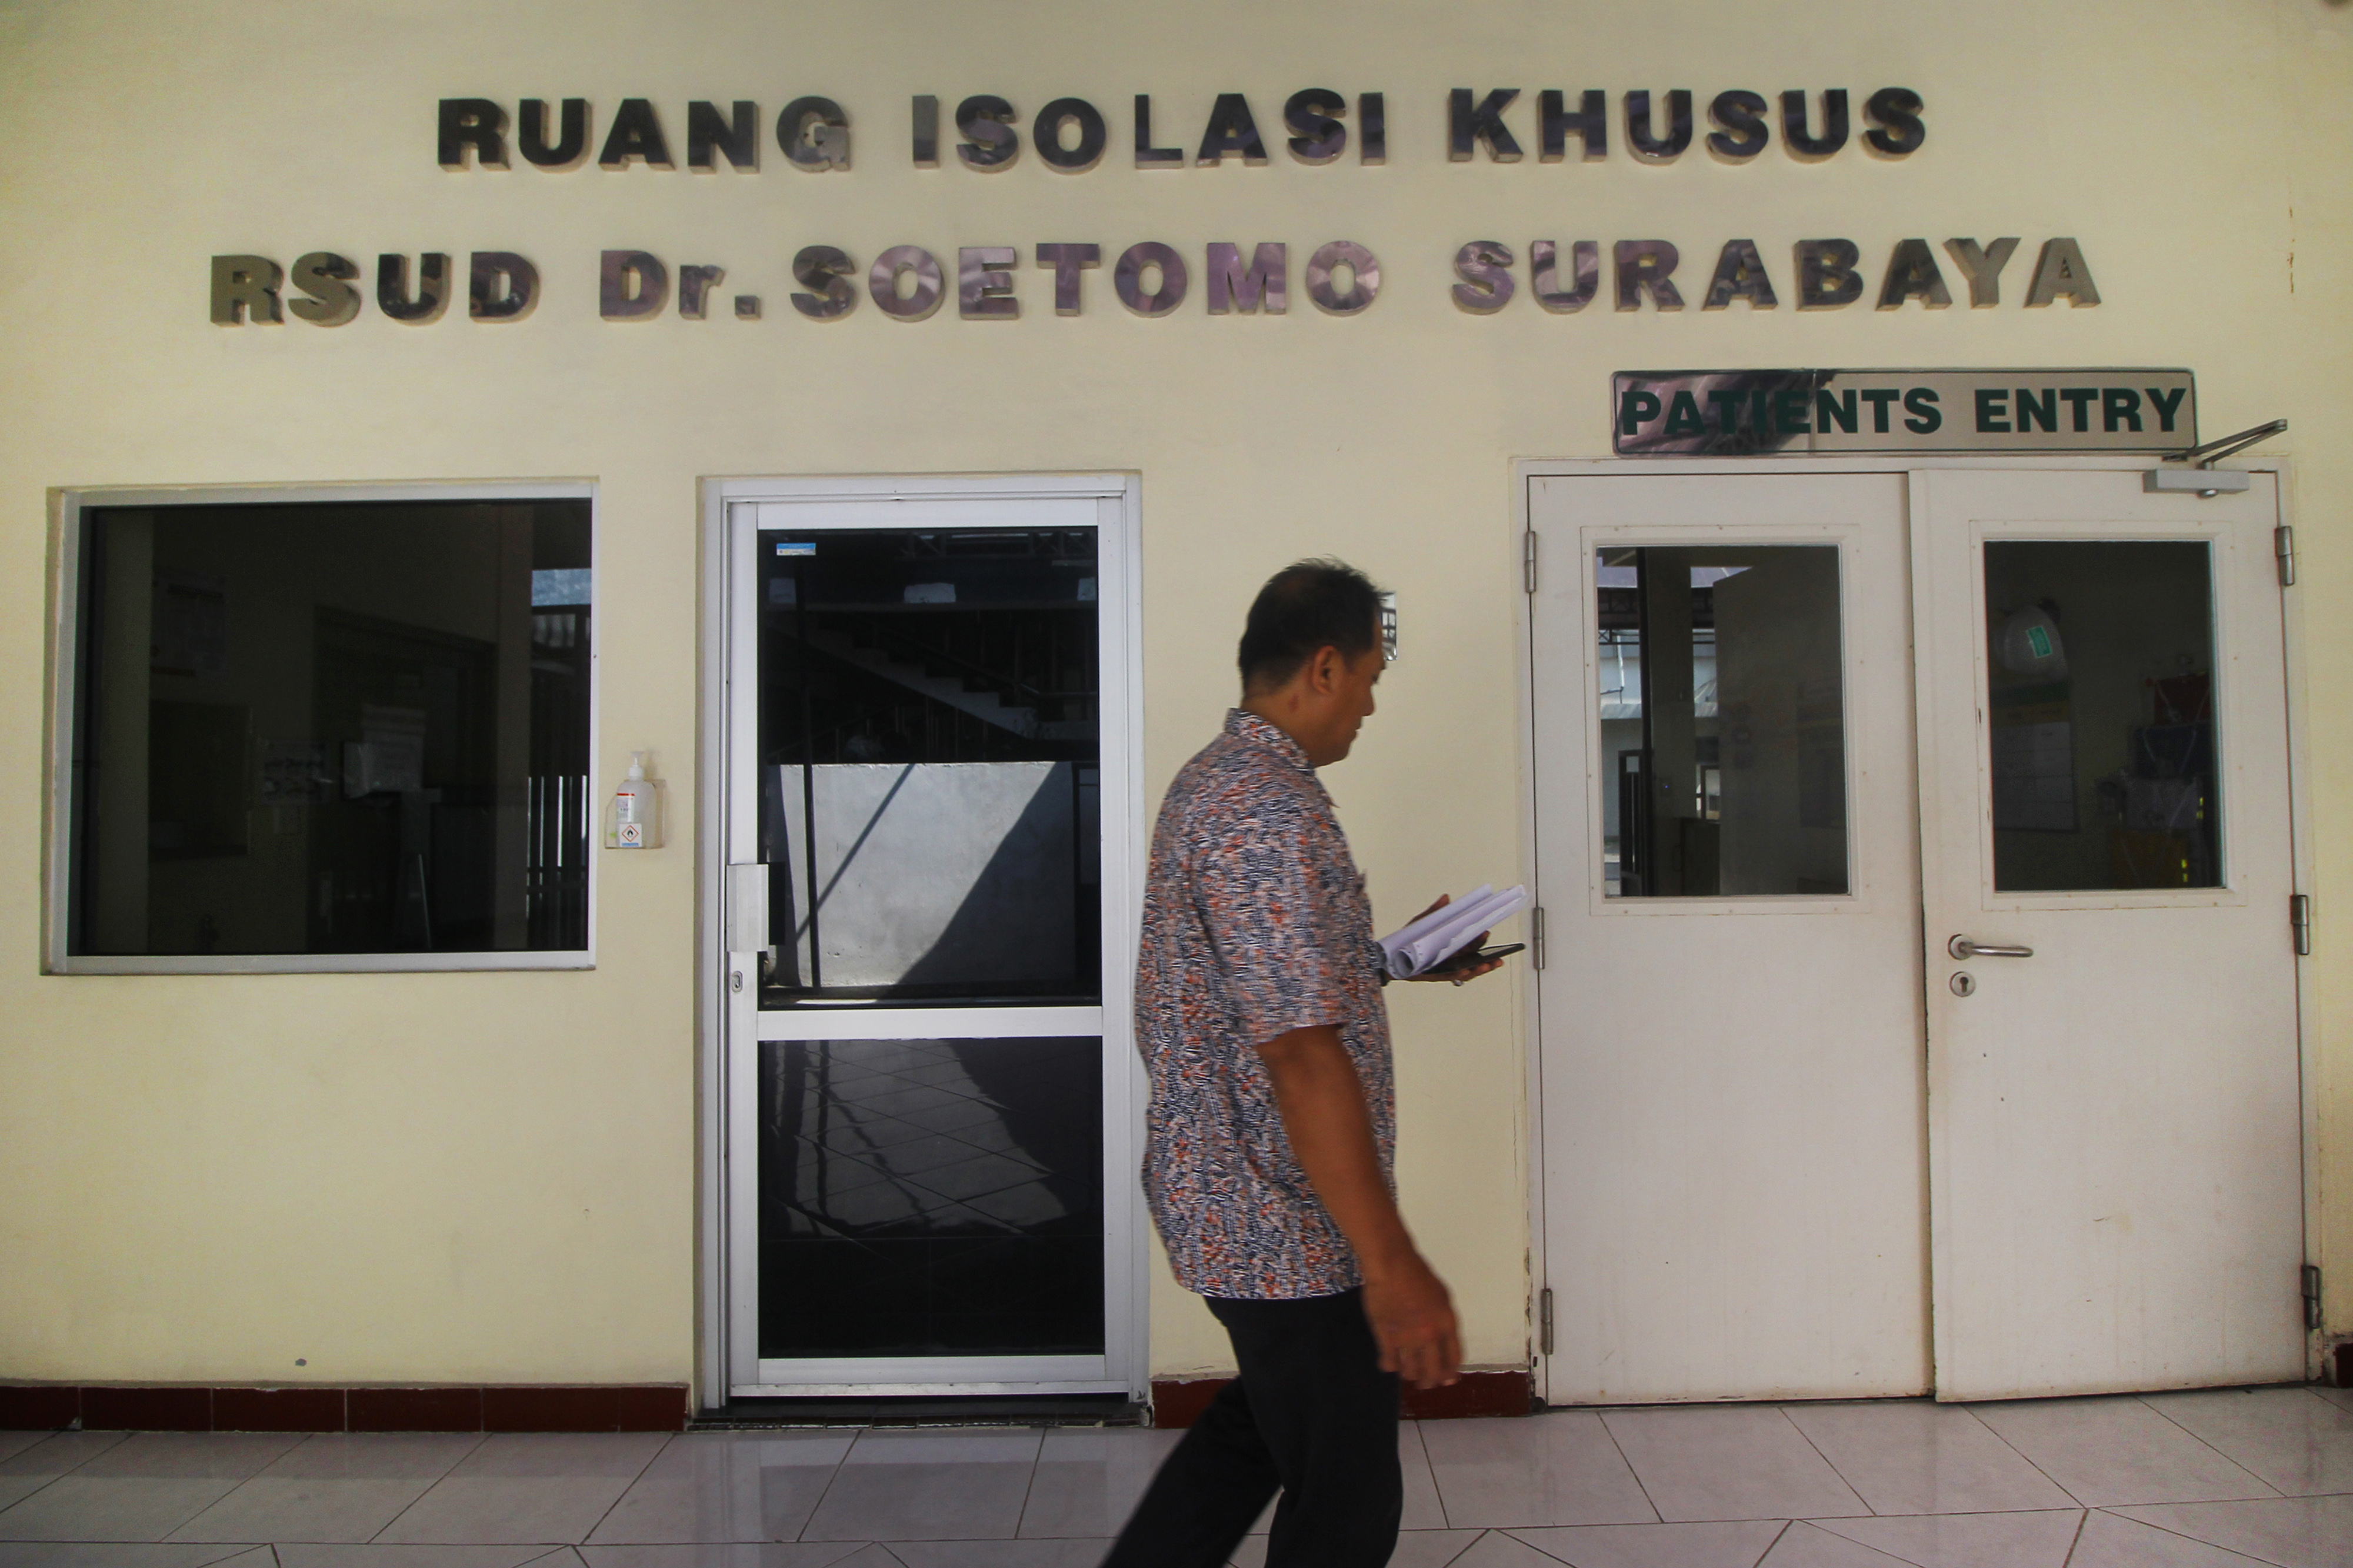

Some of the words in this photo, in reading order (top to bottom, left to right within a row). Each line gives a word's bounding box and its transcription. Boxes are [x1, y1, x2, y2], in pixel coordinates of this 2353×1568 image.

[438, 96, 852, 173] RUANG
[912, 88, 1386, 175] ISOLASI
[1447, 86, 1927, 165] KHUSUS
[210, 249, 539, 327] RSUD
[599, 249, 761, 321] Dr.
[789, 239, 1380, 323] SOETOMO
[1452, 236, 2101, 315] SURABAYA
[1621, 388, 1942, 436] PATIENTS
[1975, 388, 2187, 433] ENTRY
